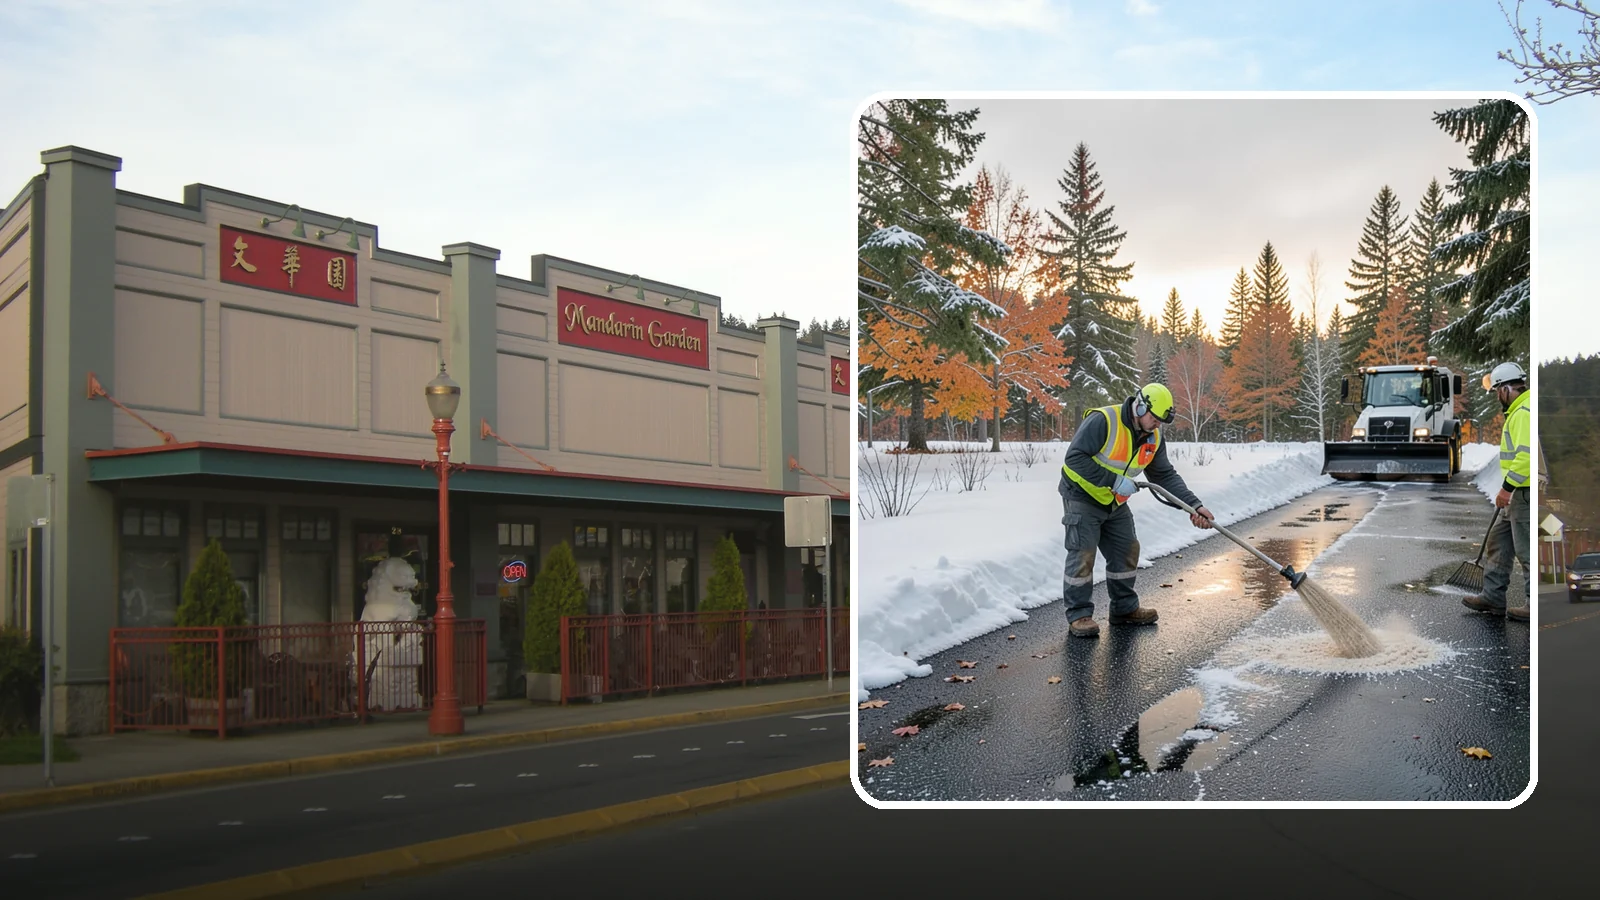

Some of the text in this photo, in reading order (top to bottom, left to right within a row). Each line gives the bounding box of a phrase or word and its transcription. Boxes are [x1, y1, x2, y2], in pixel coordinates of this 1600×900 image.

[230, 235, 347, 291] 文華園
[564, 302, 701, 352] Mandarin Garden
[503, 565, 527, 578] OPEN
